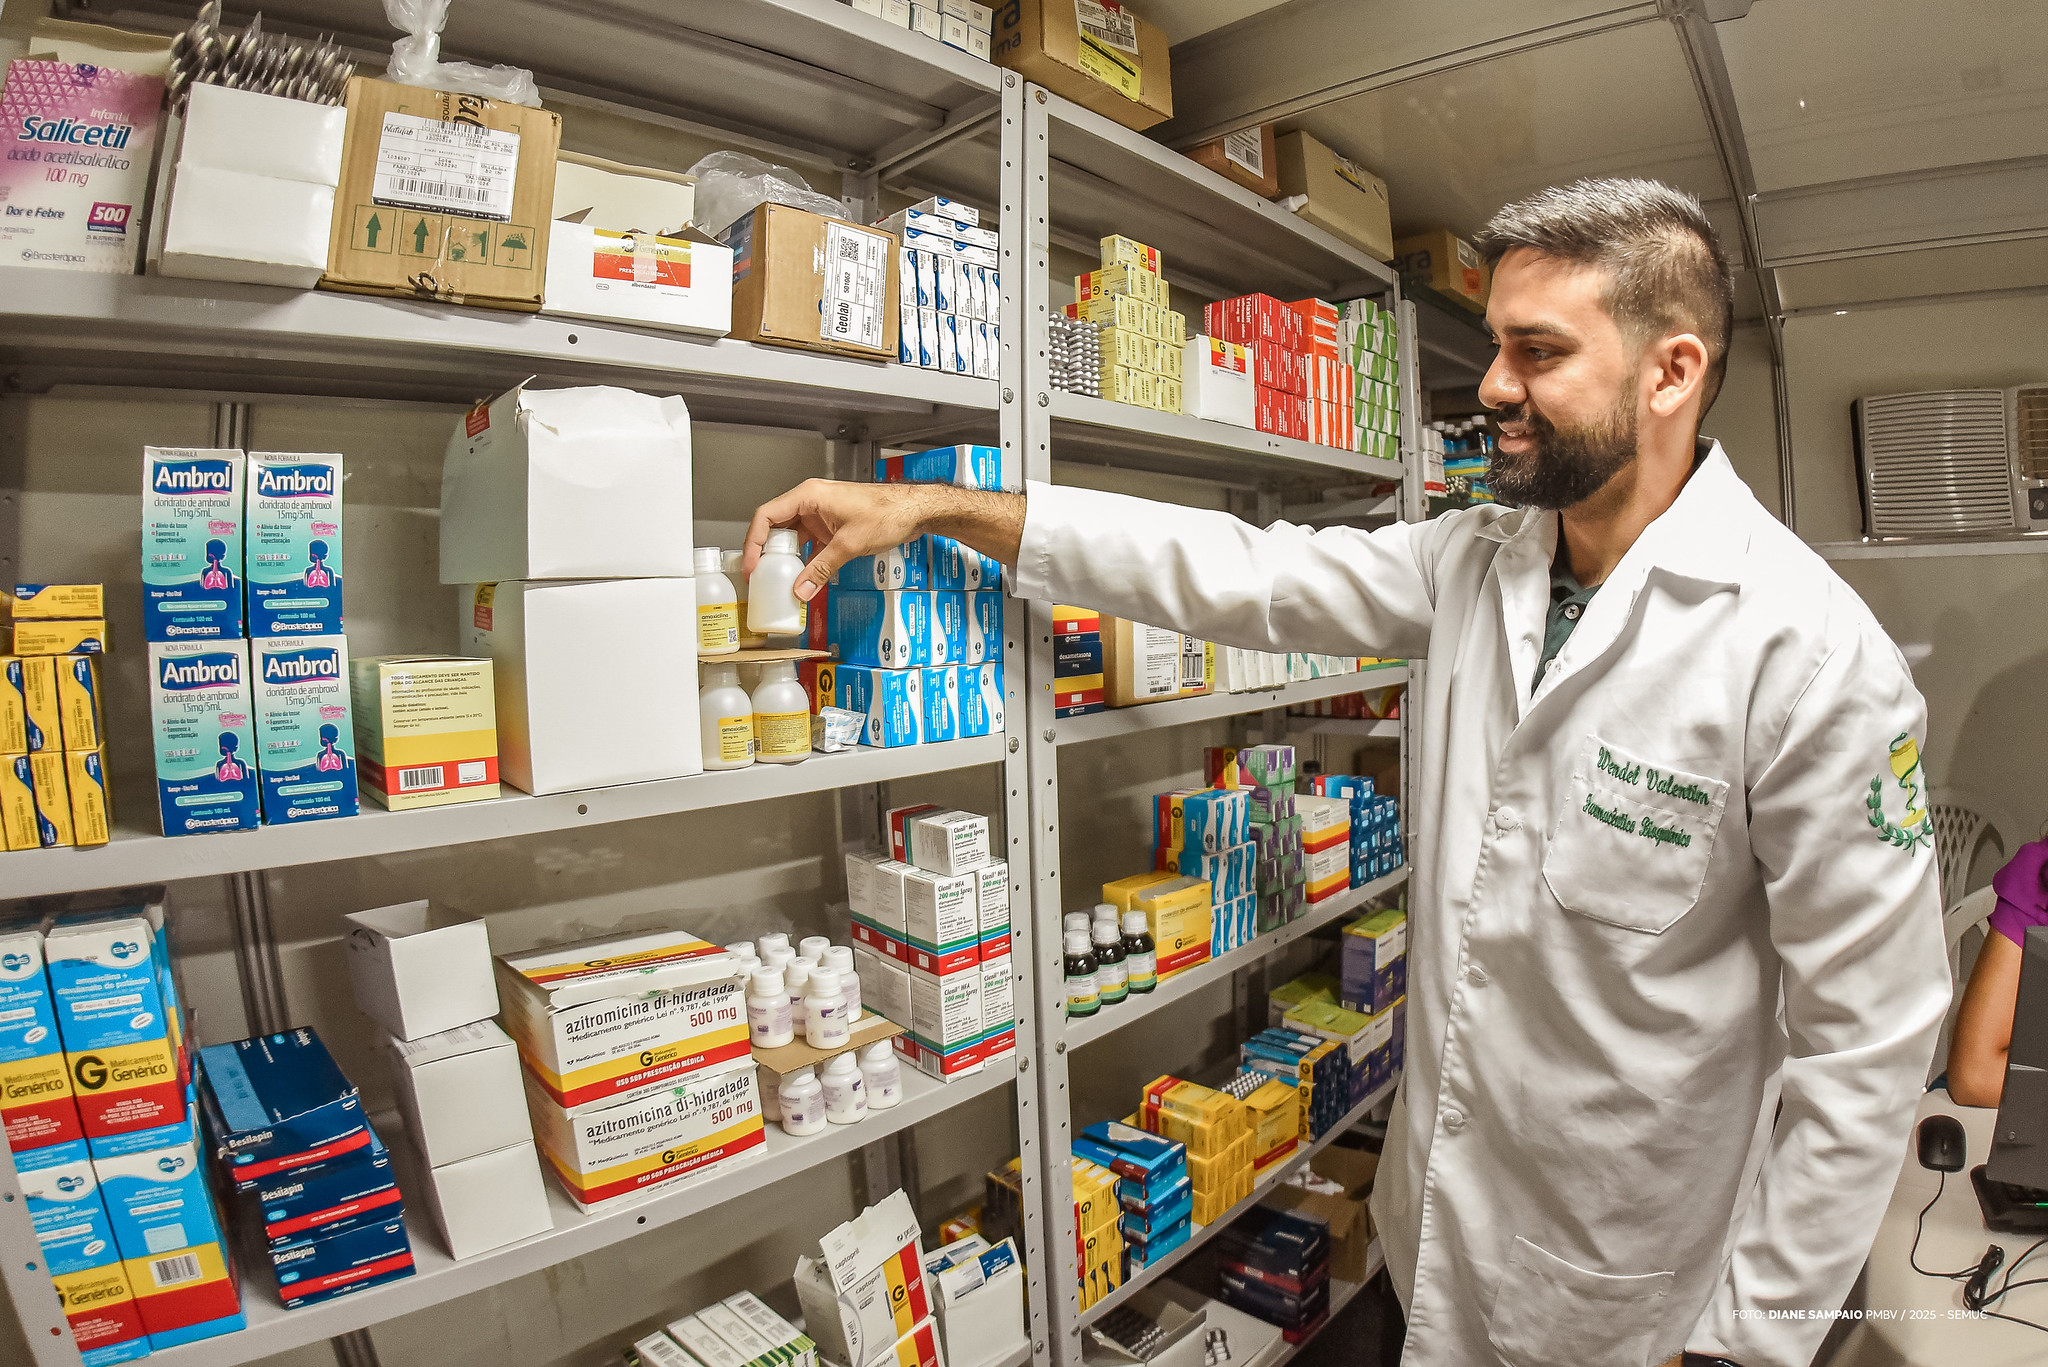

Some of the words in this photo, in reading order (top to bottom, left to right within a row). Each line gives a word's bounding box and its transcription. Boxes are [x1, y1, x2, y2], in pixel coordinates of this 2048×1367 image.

[90, 107, 129, 122] Infantil
[19, 116, 133, 150] Salicetil
[7, 149, 41, 163] ácido
[43, 149, 130, 170] acetilsalicílico
[45, 168, 66, 183] 100
[68, 173, 89, 188] mg
[6, 205, 23, 216] Dor
[26, 209, 32, 217] e
[34, 207, 65, 219] Febre
[93, 206, 126, 223] 500
[1139, 252, 1148, 264] G
[836, 302, 850, 334] Geolab
[1219, 341, 1226, 353] G
[155, 465, 230, 489] Ambrol
[260, 470, 331, 491] Ambrol
[154, 498, 187, 508] cloridrato
[188, 498, 196, 507] de
[197, 497, 230, 507] ambroxol
[259, 500, 290, 510] cloridrato
[291, 501, 299, 509] de
[300, 500, 332, 510] ambroxol
[163, 658, 238, 684] Ambrol
[266, 655, 338, 679] Ambrol
[819, 668, 834, 692] G
[163, 692, 195, 704] cloridrato
[196, 693, 206, 702] de
[206, 690, 239, 701] ambroxol
[266, 687, 297, 697] cloridrato
[298, 687, 307, 696] de
[307, 684, 339, 695] ambroxol
[1597, 746, 1641, 785] Wendel
[973, 828, 985, 838] Spray
[960, 886, 973, 896] Spray
[113, 944, 138, 954] EMS
[1175, 938, 1183, 949] G
[945, 995, 955, 1003] 200
[966, 988, 978, 998] Spray
[566, 1002, 649, 1035] azitromicina
[654, 983, 735, 1010] di-hidratada
[624, 1015, 654, 1030] genérico
[656, 1011, 668, 1020] Lei
[702, 999, 711, 1007] de
[690, 1011, 716, 1028] 500
[717, 1006, 738, 1021] mg
[110, 1053, 164, 1068] Medicamento
[640, 1051, 654, 1067] G
[654, 1051, 678, 1063] Genérico
[75, 1055, 108, 1090] G
[111, 1063, 168, 1082] Genérico
[616, 1078, 628, 1088] USO
[629, 1074, 642, 1084] SOB
[643, 1061, 680, 1080] PRESCRIÇÃO
[681, 1055, 705, 1070] MÉDICA
[7, 1077, 65, 1099] Genérico
[586, 1103, 672, 1138] azitromicina
[676, 1076, 750, 1112] di-hidratada
[647, 1116, 678, 1133] genérico
[679, 1113, 691, 1121] Lei
[723, 1098, 731, 1106] de
[711, 1110, 732, 1125] 500
[736, 1101, 753, 1119] mg
[229, 1131, 274, 1149] Besilapin
[637, 1174, 650, 1184] USO
[650, 1170, 663, 1180] SOB
[664, 1157, 701, 1177] PRESCRIÇÃO
[702, 1148, 724, 1162] MÉDICA
[662, 1150, 676, 1164] G
[1080, 1201, 1092, 1214] G
[1085, 1237, 1096, 1250] G
[273, 1246, 316, 1264] Besilapin
[834, 1247, 860, 1270] captopril
[855, 1271, 881, 1294] captopril
[70, 1286, 124, 1305] Genérico
[892, 1285, 905, 1301] G
